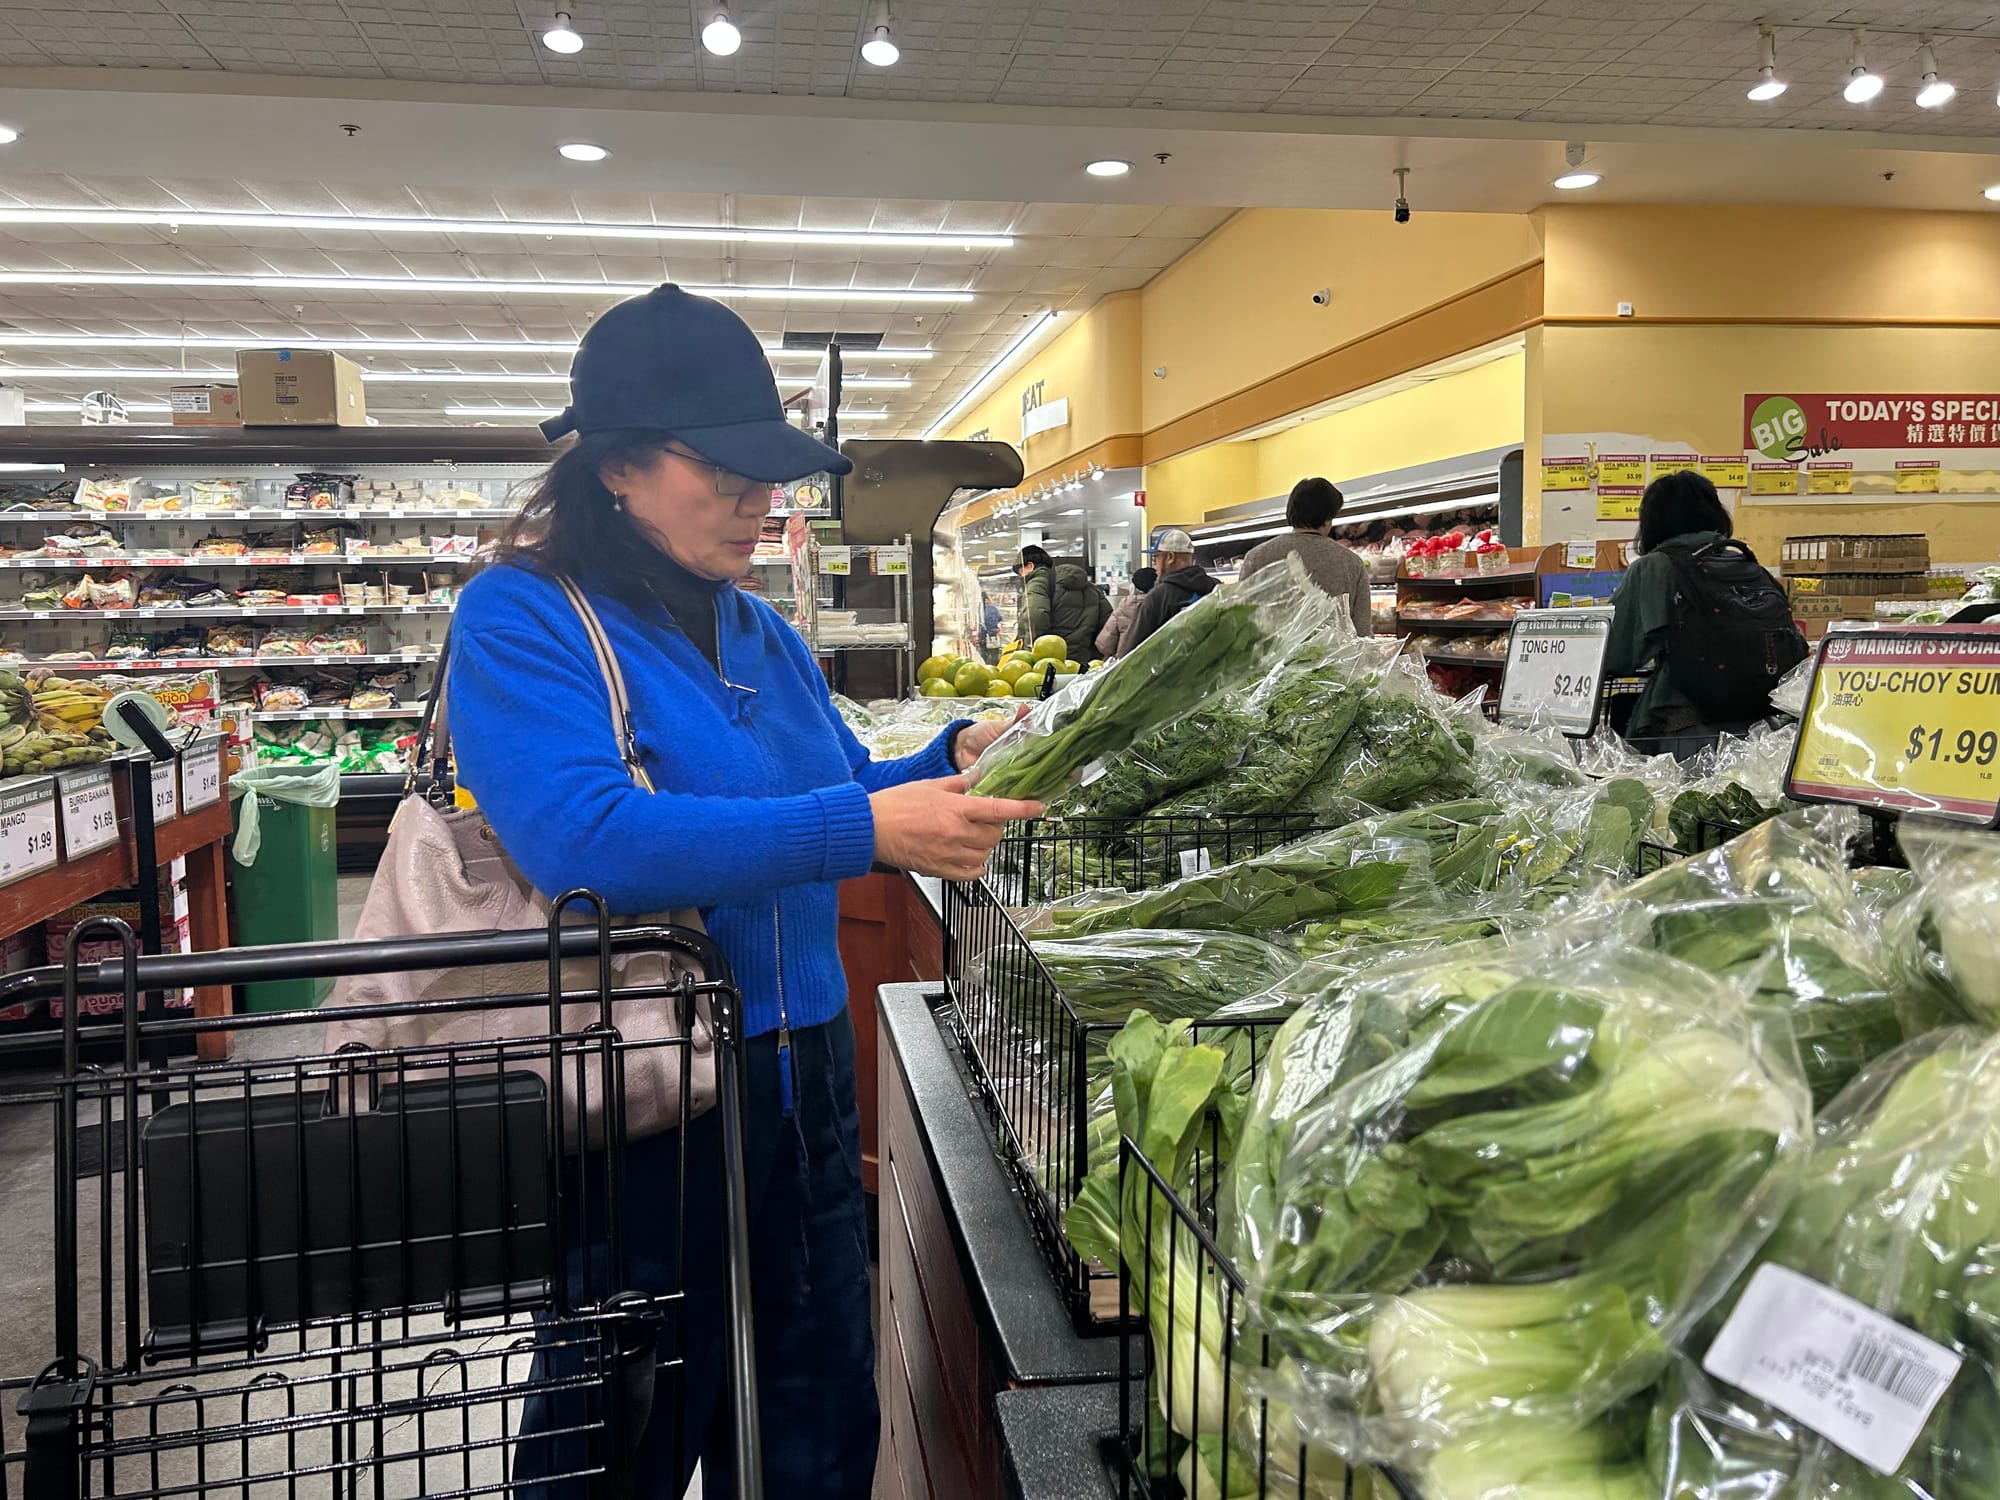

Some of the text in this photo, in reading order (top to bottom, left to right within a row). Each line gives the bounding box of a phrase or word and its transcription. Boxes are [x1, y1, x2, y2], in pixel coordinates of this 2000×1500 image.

[1826, 401, 2000, 422] TODAY'S SPECI
[1753, 408, 1805, 451] BIG
[1781, 427, 1842, 463] Sale
[1521, 640, 1566, 654] TONG HO
[1854, 639, 1937, 655] MANAGER'S
[1553, 673, 1592, 698] $2.49
[1837, 671, 1952, 694] YOU-CHOY
[1832, 693, 1863, 707] 油菜心
[1905, 724, 1998, 765] $1.99
[1979, 772, 1992, 780] 1LB
[3, 795, 25, 809] EVERYDAY
[25, 790, 38, 802] VALUE
[68, 793, 88, 808] BURRO
[88, 787, 110, 802] BANANA
[156, 790, 173, 807] $1.29
[0, 812, 26, 829] MANGO
[93, 811, 113, 830] $1.69
[28, 831, 52, 854] $1.99
